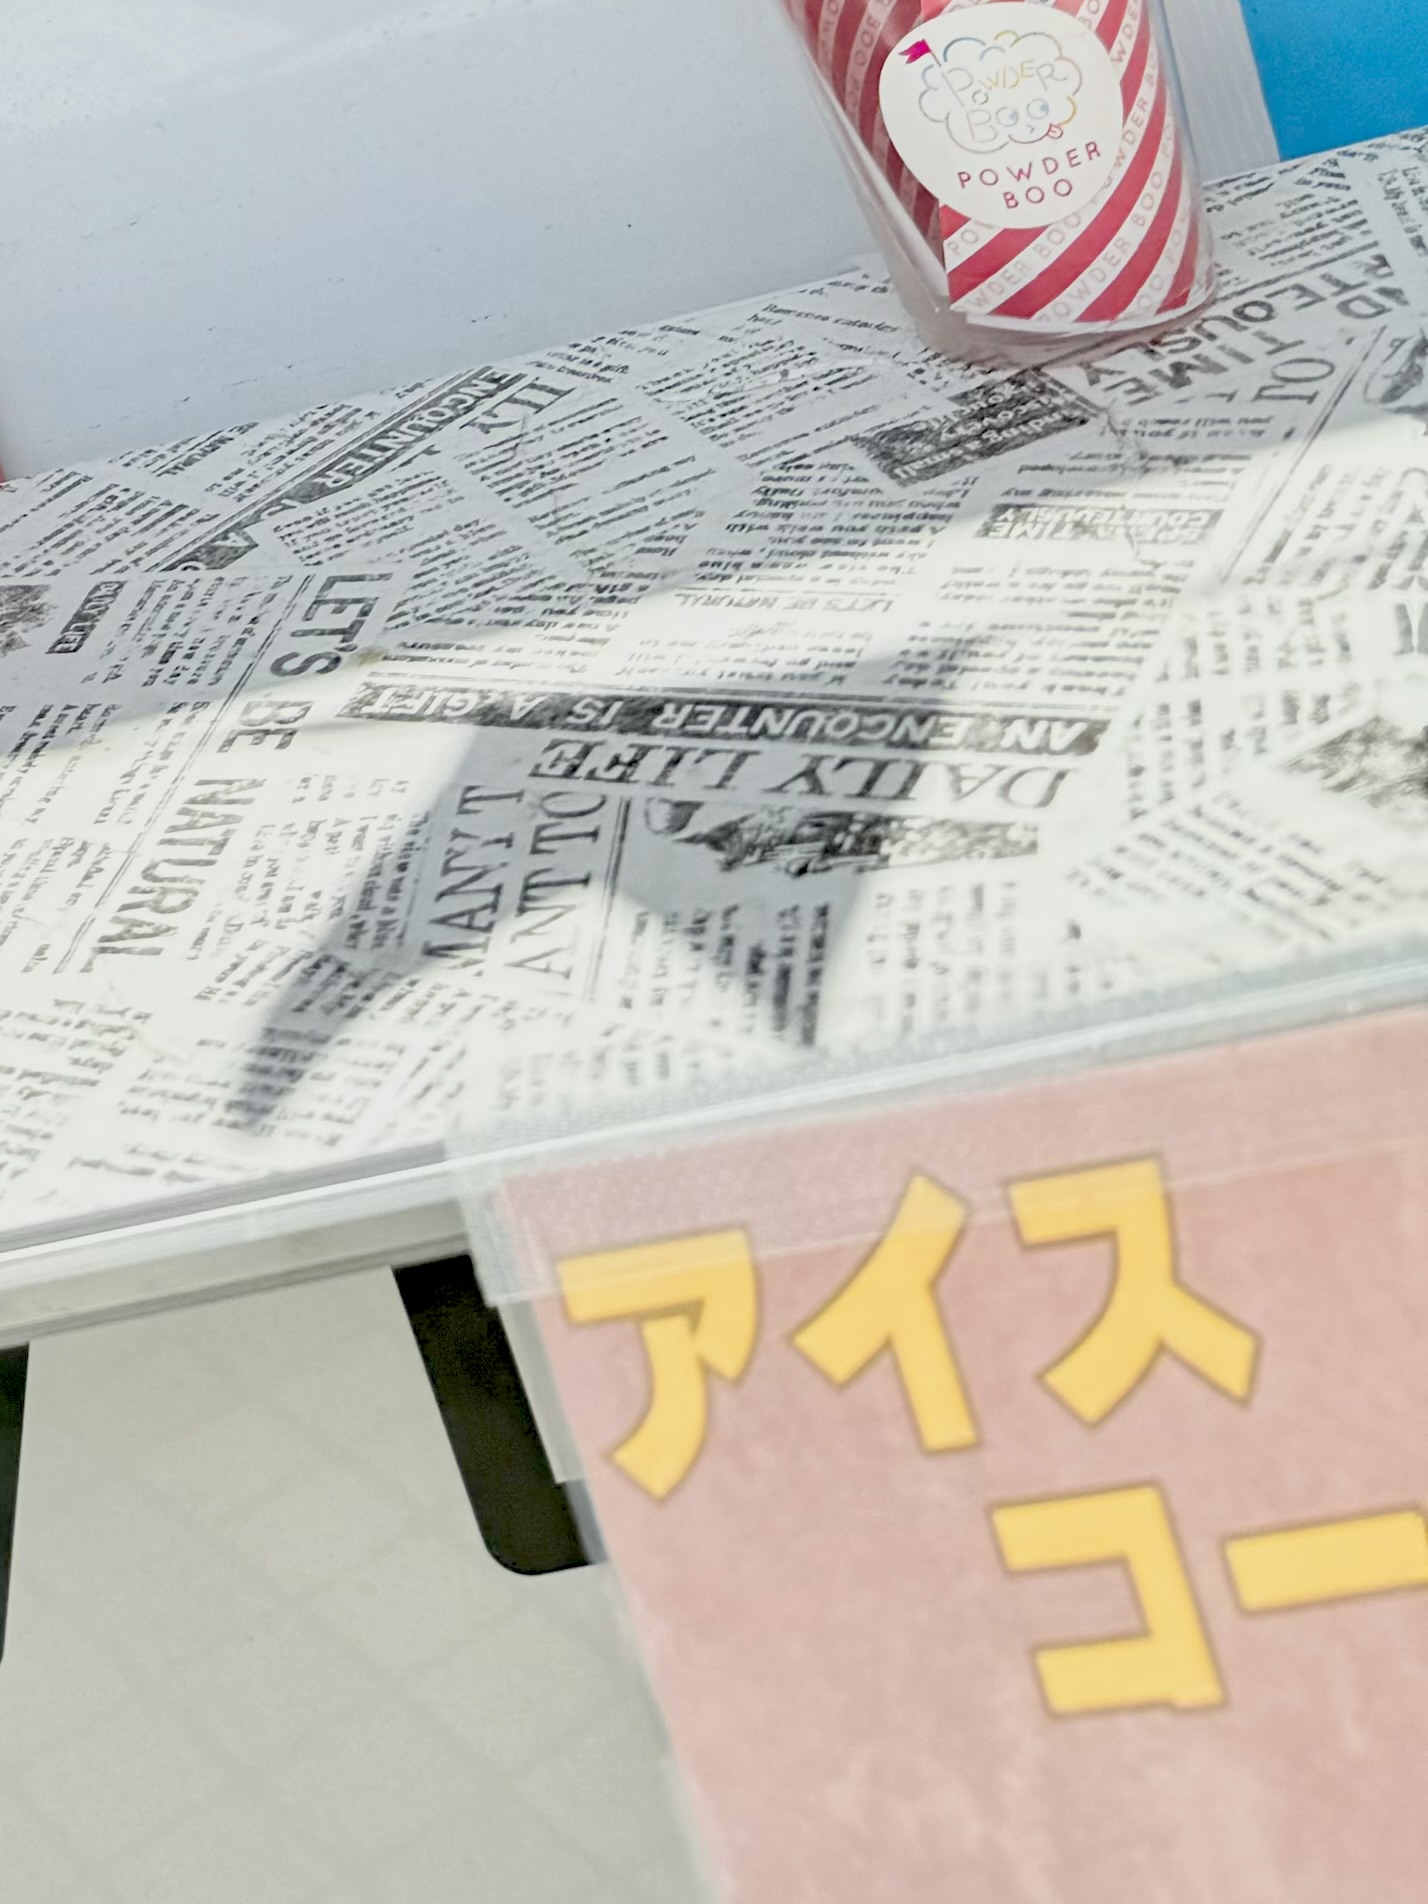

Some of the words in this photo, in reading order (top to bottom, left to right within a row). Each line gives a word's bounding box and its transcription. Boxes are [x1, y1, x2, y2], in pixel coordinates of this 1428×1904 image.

[957, 140, 1102, 190] POWDER
[1002, 178, 1073, 210] BOO
[322, 368, 510, 488] ENCOUNTER
[268, 571, 394, 678] LET'S
[217, 698, 316, 755] BE
[363, 686, 498, 721] GIFT
[509, 695, 544, 722] A
[567, 698, 620, 728] IS
[655, 700, 966, 746] ENCOUNTER
[1001, 717, 1095, 750] AN
[531, 737, 760, 790] LIFE
[782, 755, 1079, 809] DAILY
[76, 778, 256, 975] NATURAL
[554, 1151, 1262, 1505] アイス
